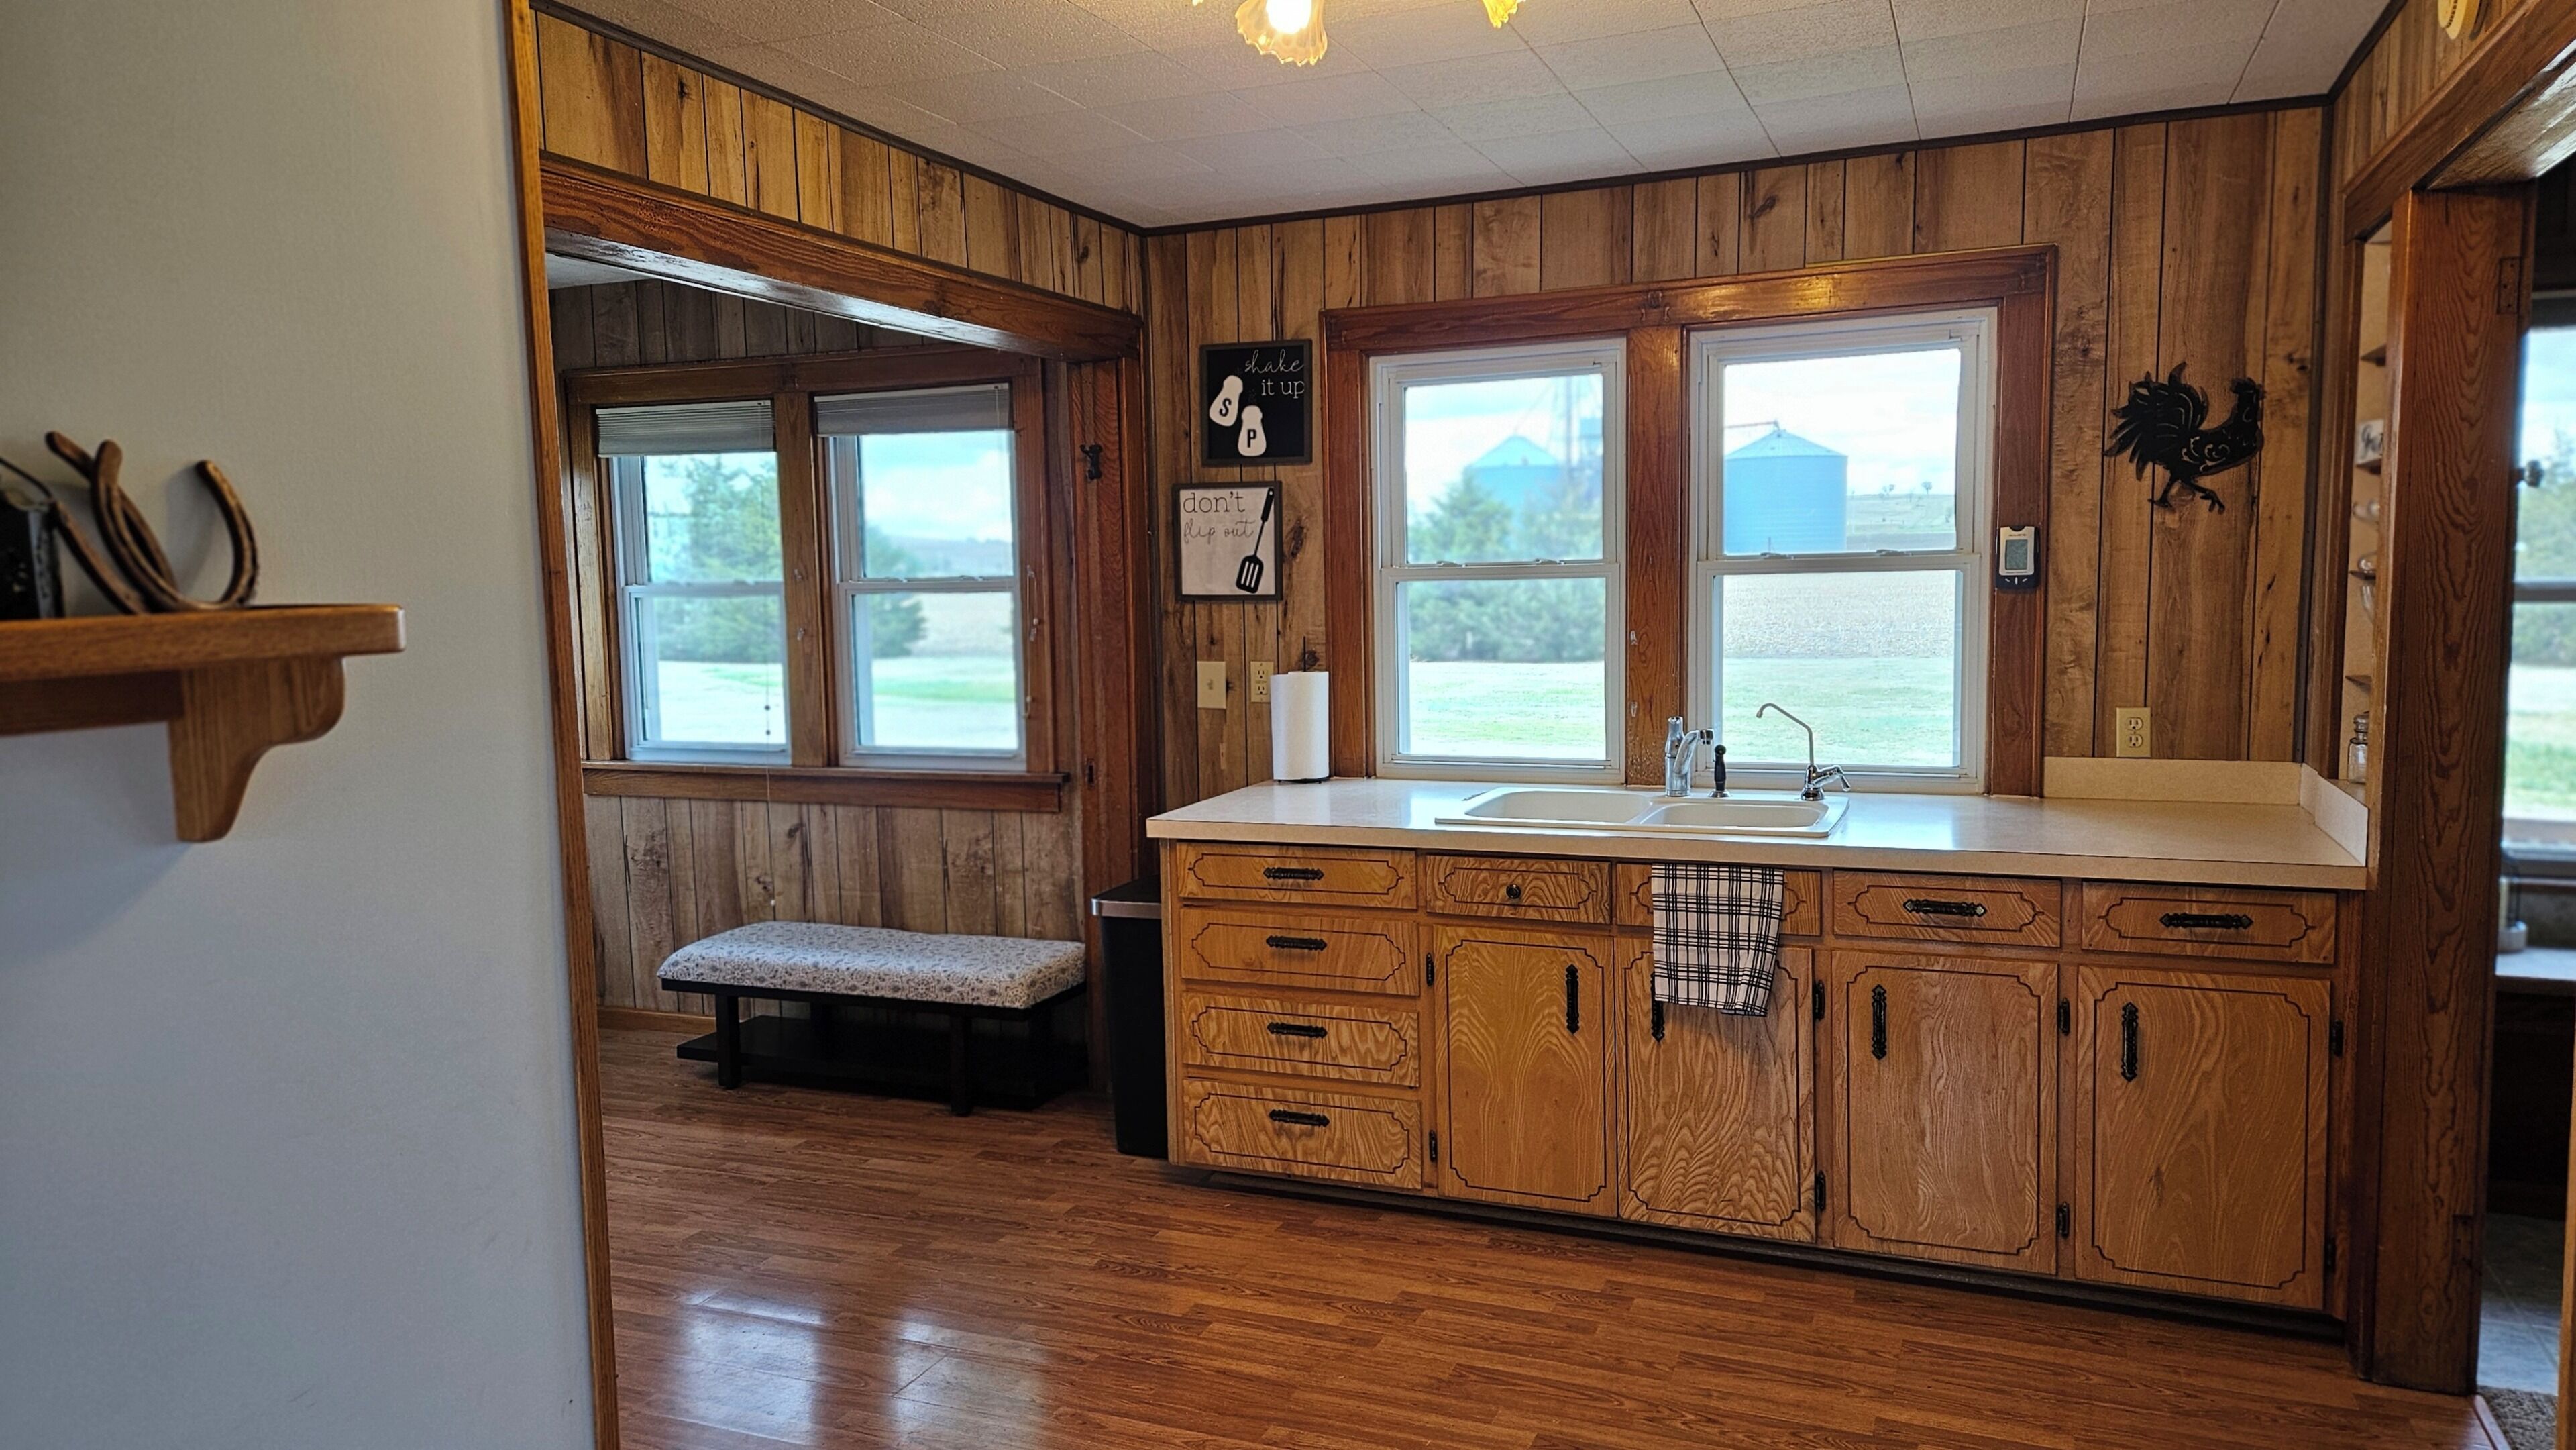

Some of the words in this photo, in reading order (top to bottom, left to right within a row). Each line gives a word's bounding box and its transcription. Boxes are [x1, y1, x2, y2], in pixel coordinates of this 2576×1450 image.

[1244, 349, 1304, 374] shake
[1261, 378, 1275, 396] it
[1280, 380, 1305, 399] up
[1219, 398, 1232, 417] S
[1247, 429, 1256, 448] P
[1183, 491, 1246, 513] don't
[1184, 518, 1216, 545] flip
[1224, 518, 1256, 538] out
